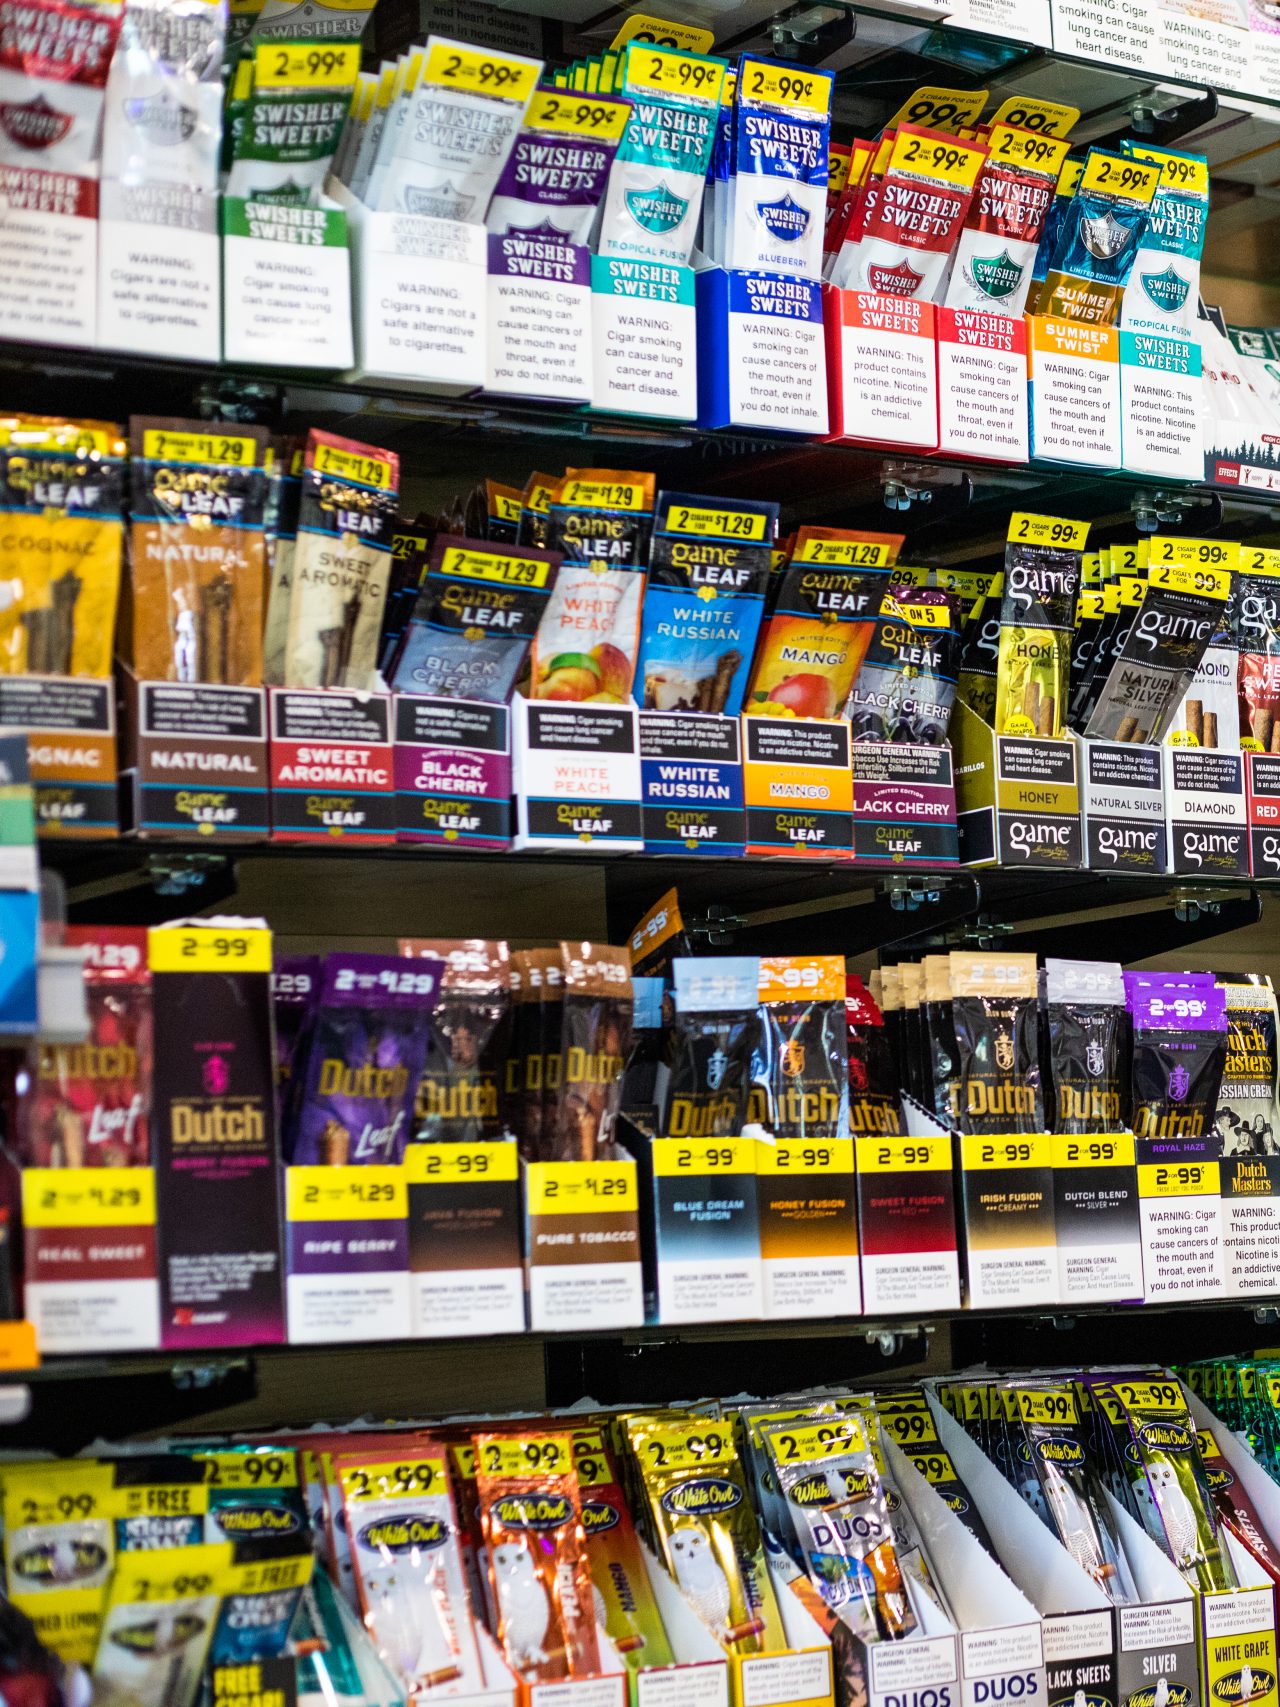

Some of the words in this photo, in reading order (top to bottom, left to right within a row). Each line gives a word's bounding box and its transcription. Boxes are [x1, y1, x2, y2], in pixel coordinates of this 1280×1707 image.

[752, 72, 763, 94] 2
[778, 77, 813, 102] 99¢
[253, 103, 344, 124] SWISHER
[254, 123, 335, 145] SWEETS
[746, 116, 822, 149] SWISHER
[516, 144, 605, 170] SWISHER
[750, 138, 817, 168] SWEETS
[516, 165, 596, 188] SWEETS
[758, 253, 806, 268] BLUEBERRY
[1046, 324, 1108, 344] SUMMER
[857, 346, 904, 361] WARNING:
[906, 353, 924, 363] This
[1056, 339, 1099, 355] TWIST
[854, 361, 887, 375] product
[890, 365, 926, 378] contains
[853, 375, 892, 390] nicotine.
[894, 379, 928, 394] Nicotine
[860, 390, 868, 401] is
[871, 393, 881, 401] an
[884, 394, 922, 407] addictive
[871, 407, 912, 420] chemical.
[1263, 436, 1276, 444] HIGH
[1218, 467, 1238, 478] EFFECTS
[678, 510, 690, 528] 2
[716, 514, 754, 535] $1.29
[1018, 519, 1028, 537] 2
[1032, 523, 1049, 531] CIGARS
[1051, 524, 1077, 542] 99¢
[672, 543, 740, 576] game
[1252, 553, 1264, 569] 2
[692, 567, 750, 586] LEAF
[151, 750, 257, 772] NATURAL
[297, 748, 370, 765] SWEET
[279, 766, 388, 784] AROMATIC
[422, 762, 482, 779] BLACK
[659, 766, 719, 782] WHITE
[415, 776, 487, 794] CHERRY
[649, 782, 730, 799] RUSSIAN
[770, 784, 829, 798] MANGO
[874, 788, 900, 797] LIMITED
[901, 788, 924, 798] EDITION
[1019, 791, 1058, 804] HONEY
[1091, 797, 1132, 810] NATURAL
[1134, 800, 1161, 811] SILVER
[1185, 802, 1235, 815] DIAMOND
[1257, 807, 1279, 817] RED
[1009, 821, 1071, 859] game
[172, 1106, 264, 1143] Dutch
[1153, 1144, 1180, 1152] ROYAL
[1183, 1143, 1205, 1152] HAZE
[1157, 1169, 1168, 1184] 2
[980, 1194, 1006, 1203] IRISH
[1008, 1193, 1042, 1201] FUSION
[1065, 1192, 1093, 1200] DUTCH
[1098, 1191, 1128, 1199] BLEND
[674, 1202, 703, 1211] BLUE
[707, 1201, 744, 1211] DREAM
[771, 1201, 806, 1210] HONEY
[808, 1200, 845, 1208] FUSION
[1087, 1201, 1108, 1209] SILVER
[690, 1211, 730, 1221] FUSION
[304, 1242, 343, 1253] RIPE
[346, 1240, 397, 1252] BERRY
[537, 1233, 575, 1245] PURE
[579, 1232, 636, 1243] TOBACCO
[1121, 1386, 1140, 1405] 2
[1136, 1389, 1150, 1397] CIGARS
[1150, 1383, 1180, 1405] 99¢
[1146, 1426, 1171, 1444] White
[1171, 1429, 1191, 1446] Owl
[814, 1518, 883, 1546] DUOS
[1215, 1644, 1241, 1661] WHITE
[1244, 1641, 1269, 1657] GRAPE
[1143, 1655, 1177, 1674] SILVER
[973, 1674, 1037, 1703] DUOS
